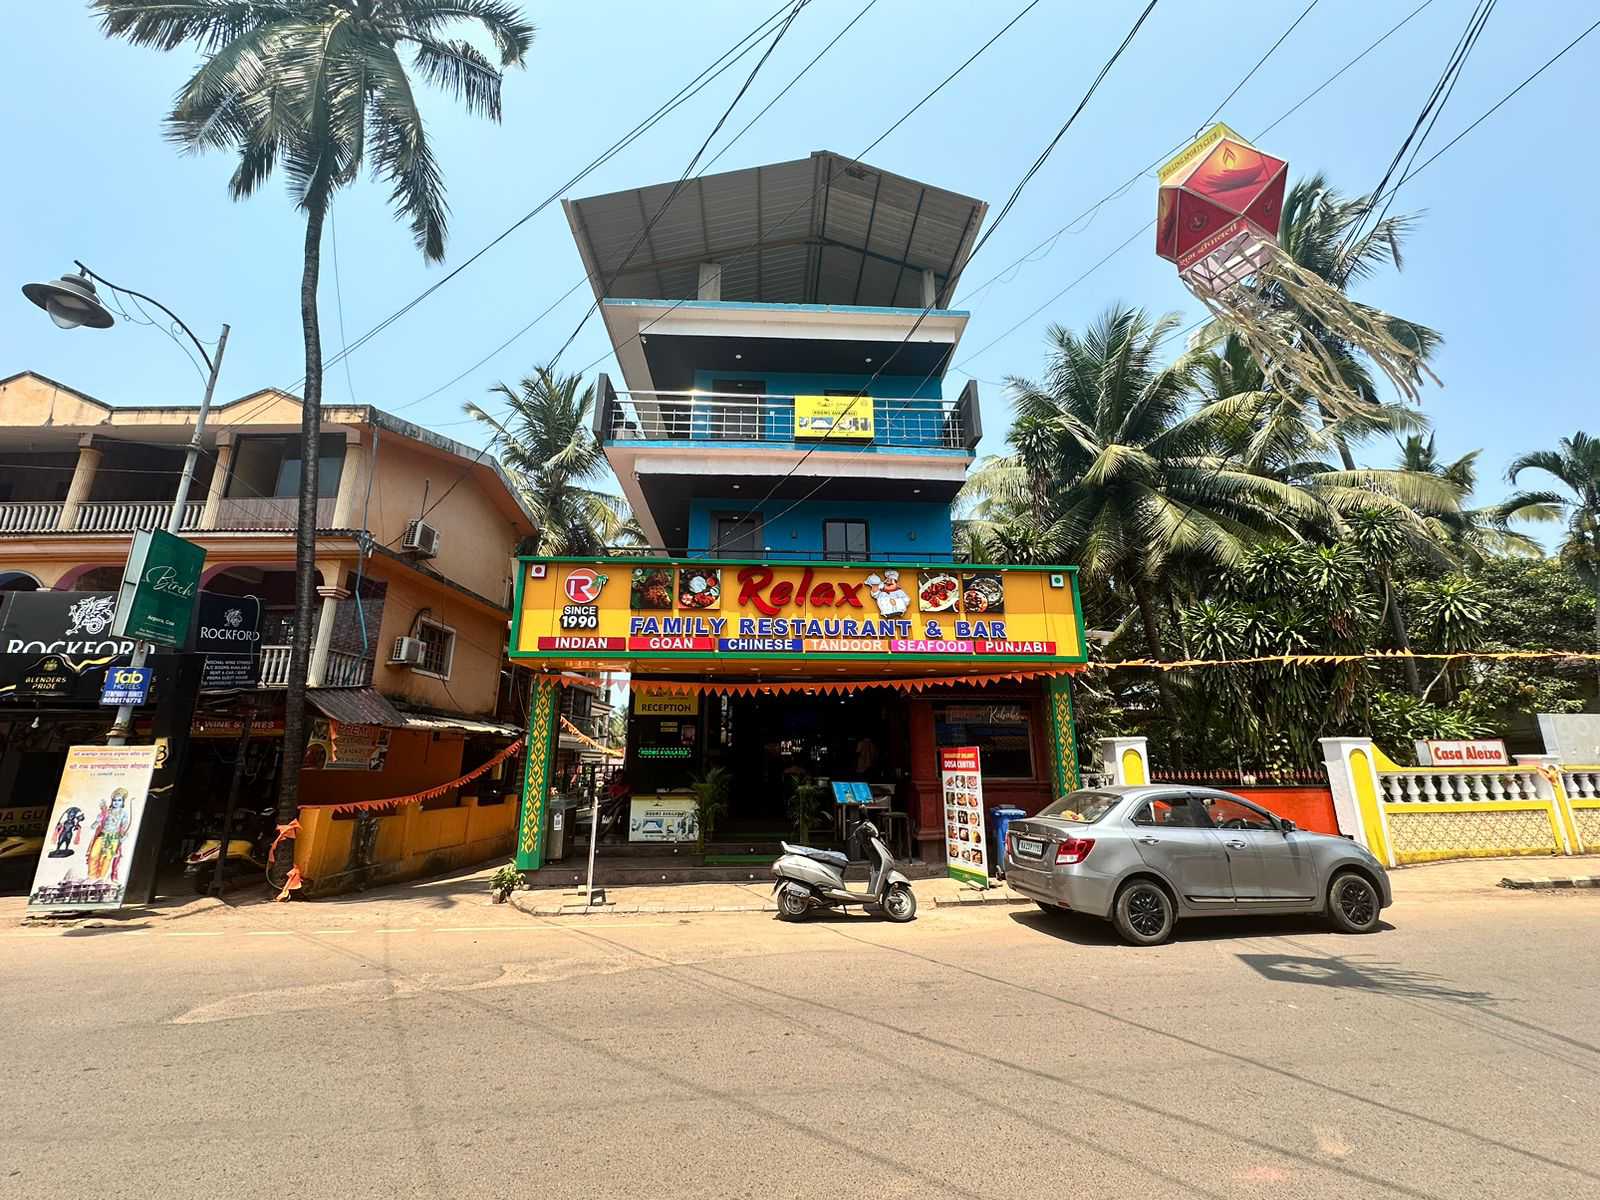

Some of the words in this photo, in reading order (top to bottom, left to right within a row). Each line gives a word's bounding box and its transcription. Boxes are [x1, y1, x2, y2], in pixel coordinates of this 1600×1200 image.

[737, 566, 864, 616] Relax
[564, 605, 597, 616] SINCE
[561, 615, 598, 628] 1990
[630, 617, 728, 636] FAMILY
[739, 618, 912, 638] RESTAURANT
[926, 620, 942, 638] &
[954, 621, 1007, 638] BAR
[200, 626, 260, 641] ROCKFORD
[7, 639, 156, 654] ROCKFOR
[555, 637, 608, 649] INDIAN
[649, 638, 694, 650] GOAN
[728, 638, 793, 650] CHINESE
[811, 640, 883, 652] TANDOOR
[898, 640, 967, 652] SEAFOOD
[985, 641, 1048, 653] PUNJABI
[25, 676, 66, 684] BLENDERS
[114, 669, 144, 684] fab
[642, 703, 691, 712] RECEPTION
[1434, 746, 1462, 760] Casa
[1466, 746, 1502, 760] Aleixo
